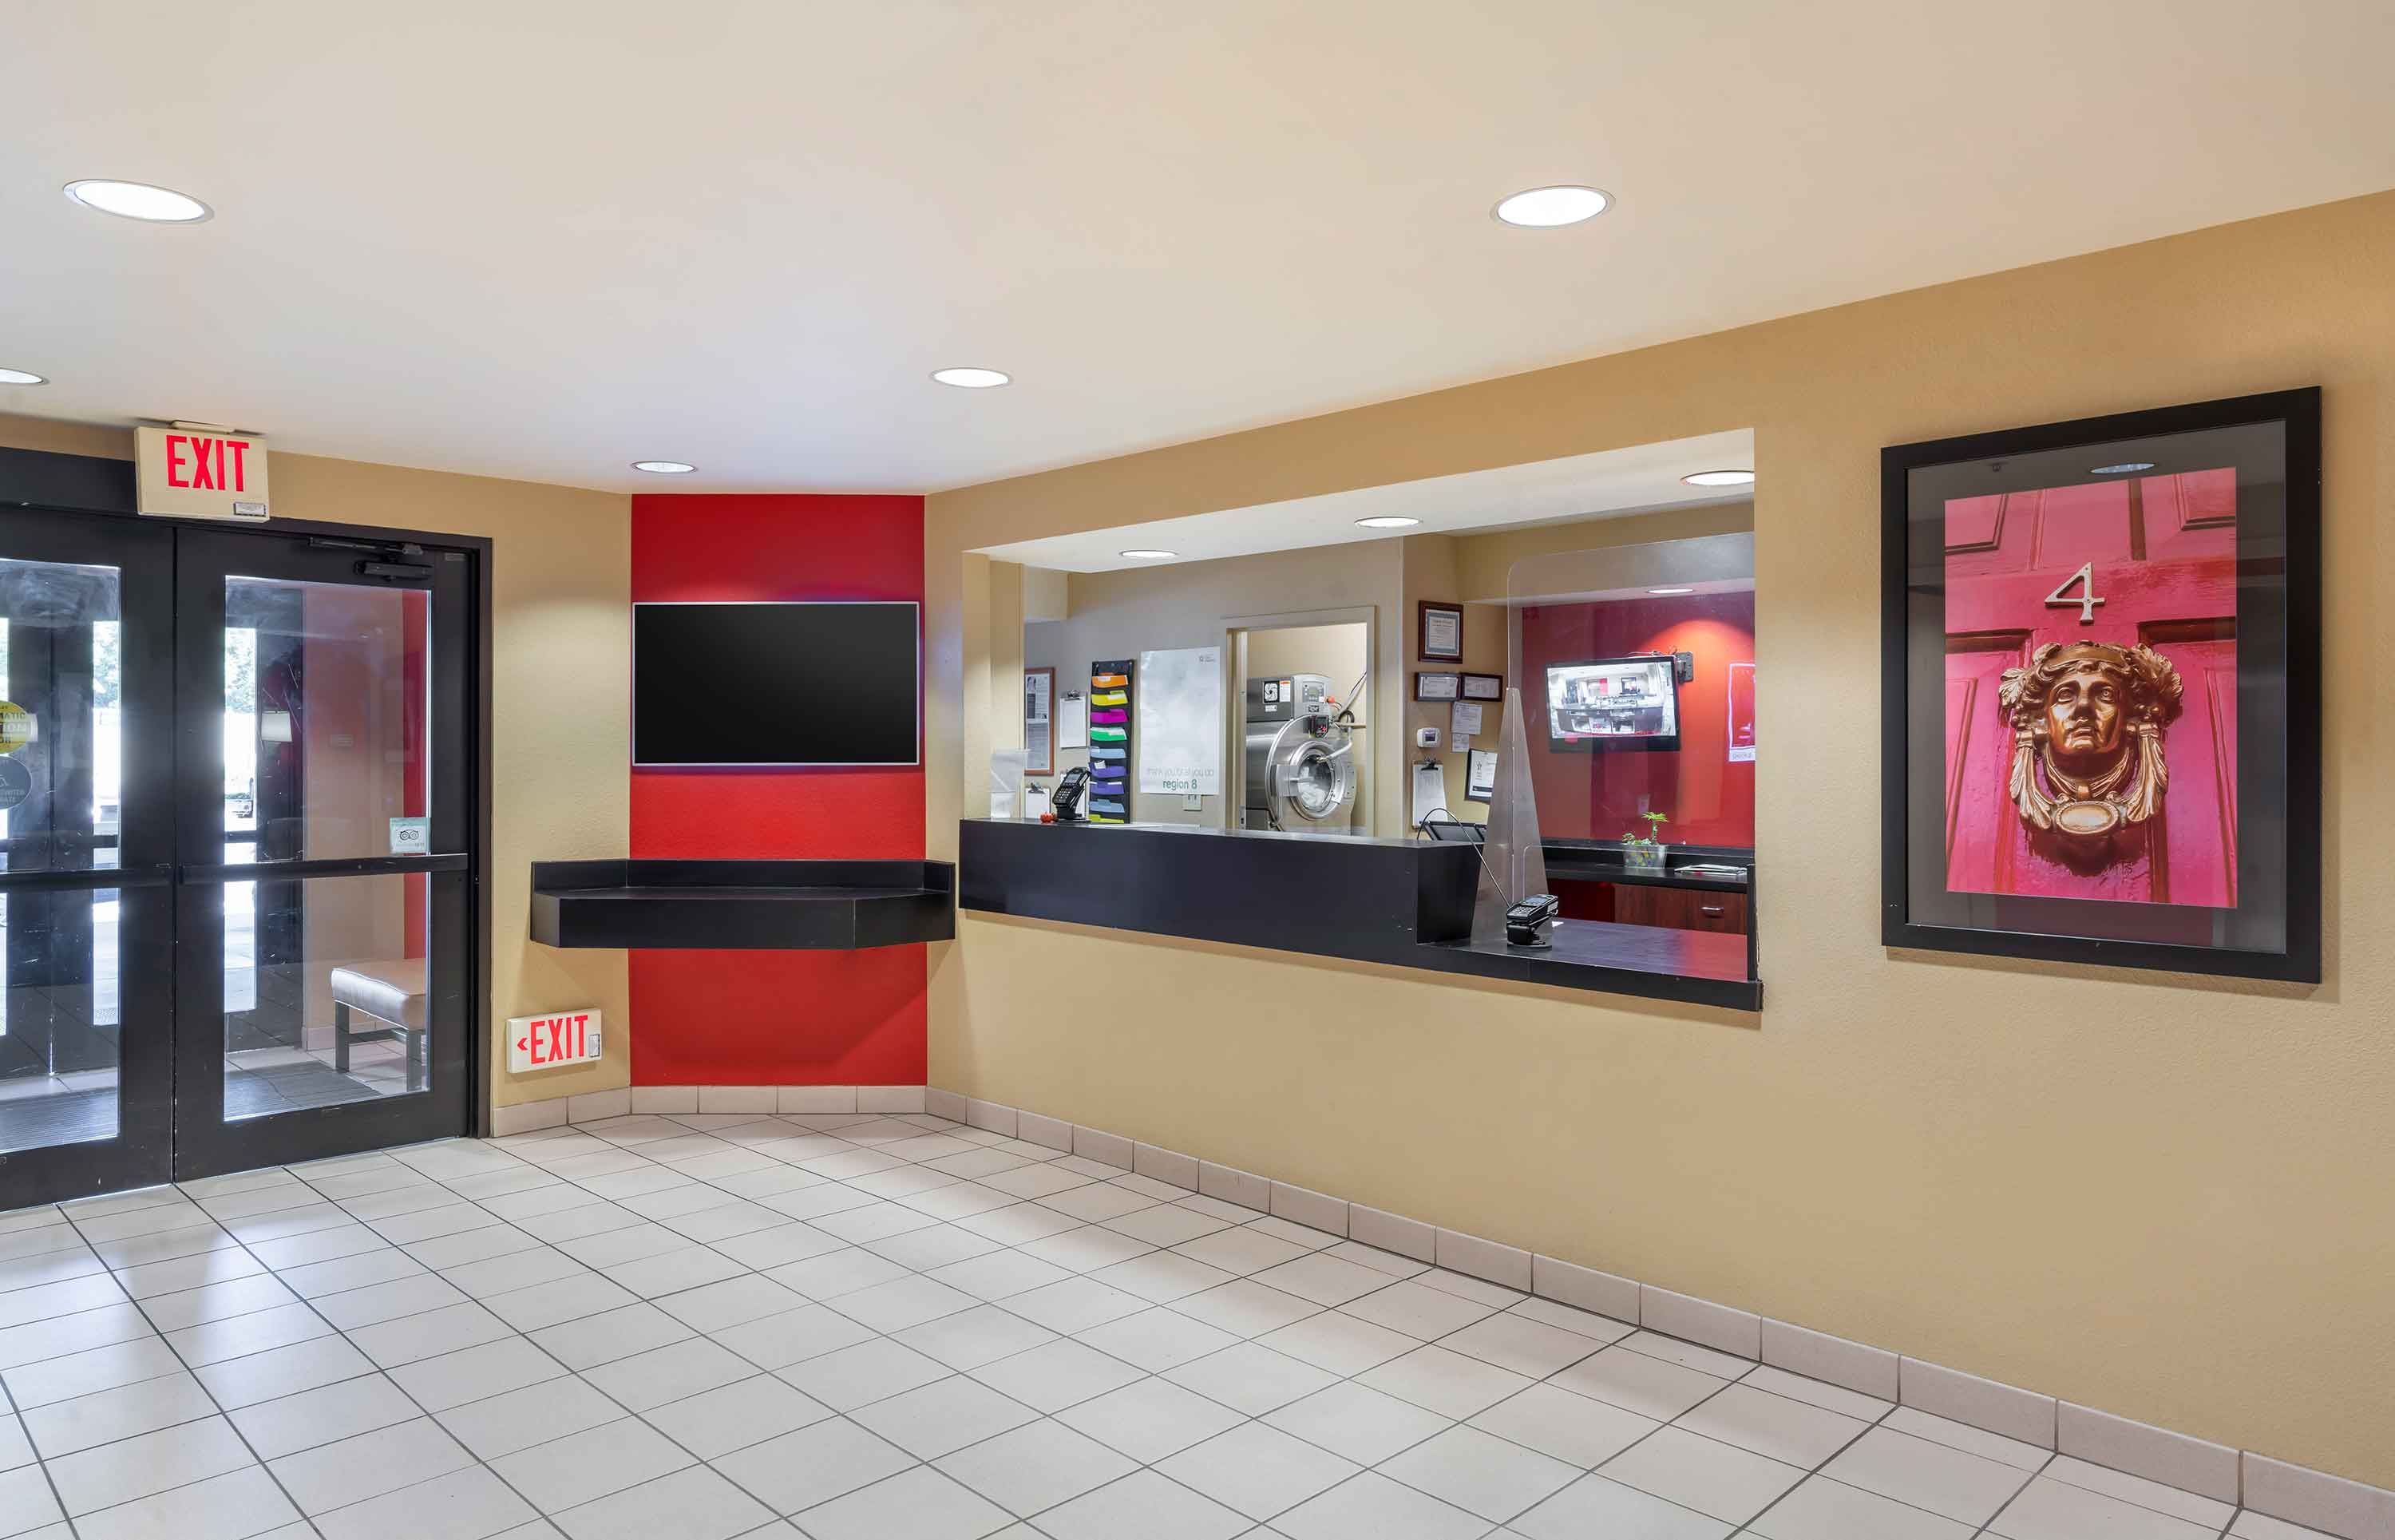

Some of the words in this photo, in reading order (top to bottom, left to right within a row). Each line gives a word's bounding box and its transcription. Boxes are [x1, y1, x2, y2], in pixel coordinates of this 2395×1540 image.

[166, 434, 249, 492] EXIT
[2044, 561, 2105, 623] 4
[1162, 778, 1189, 790] region
[1191, 778, 1198, 790] 8
[531, 1015, 588, 1064] EXIT
